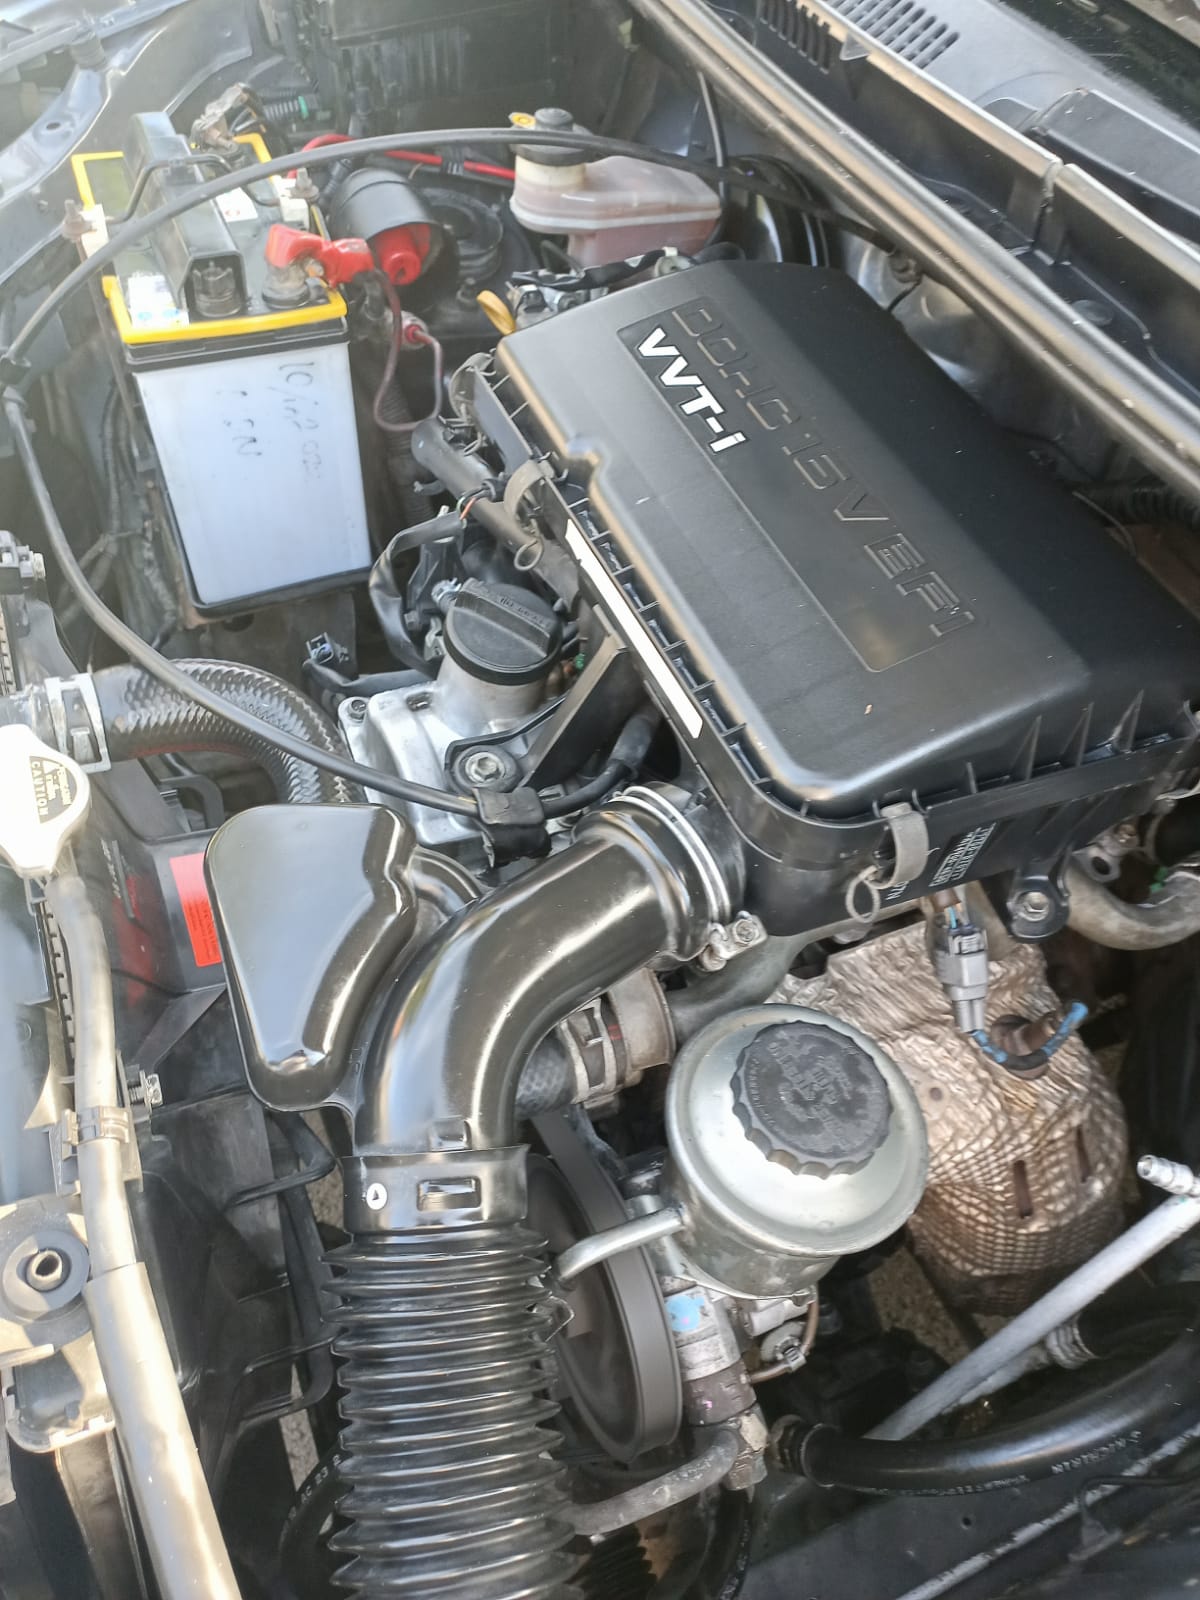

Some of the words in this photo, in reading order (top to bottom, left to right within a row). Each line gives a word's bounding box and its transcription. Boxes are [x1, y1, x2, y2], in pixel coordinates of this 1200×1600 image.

[670, 306, 803, 431] DOHC
[864, 532, 976, 638] EFI
[31, 760, 49, 815] CAUTION
